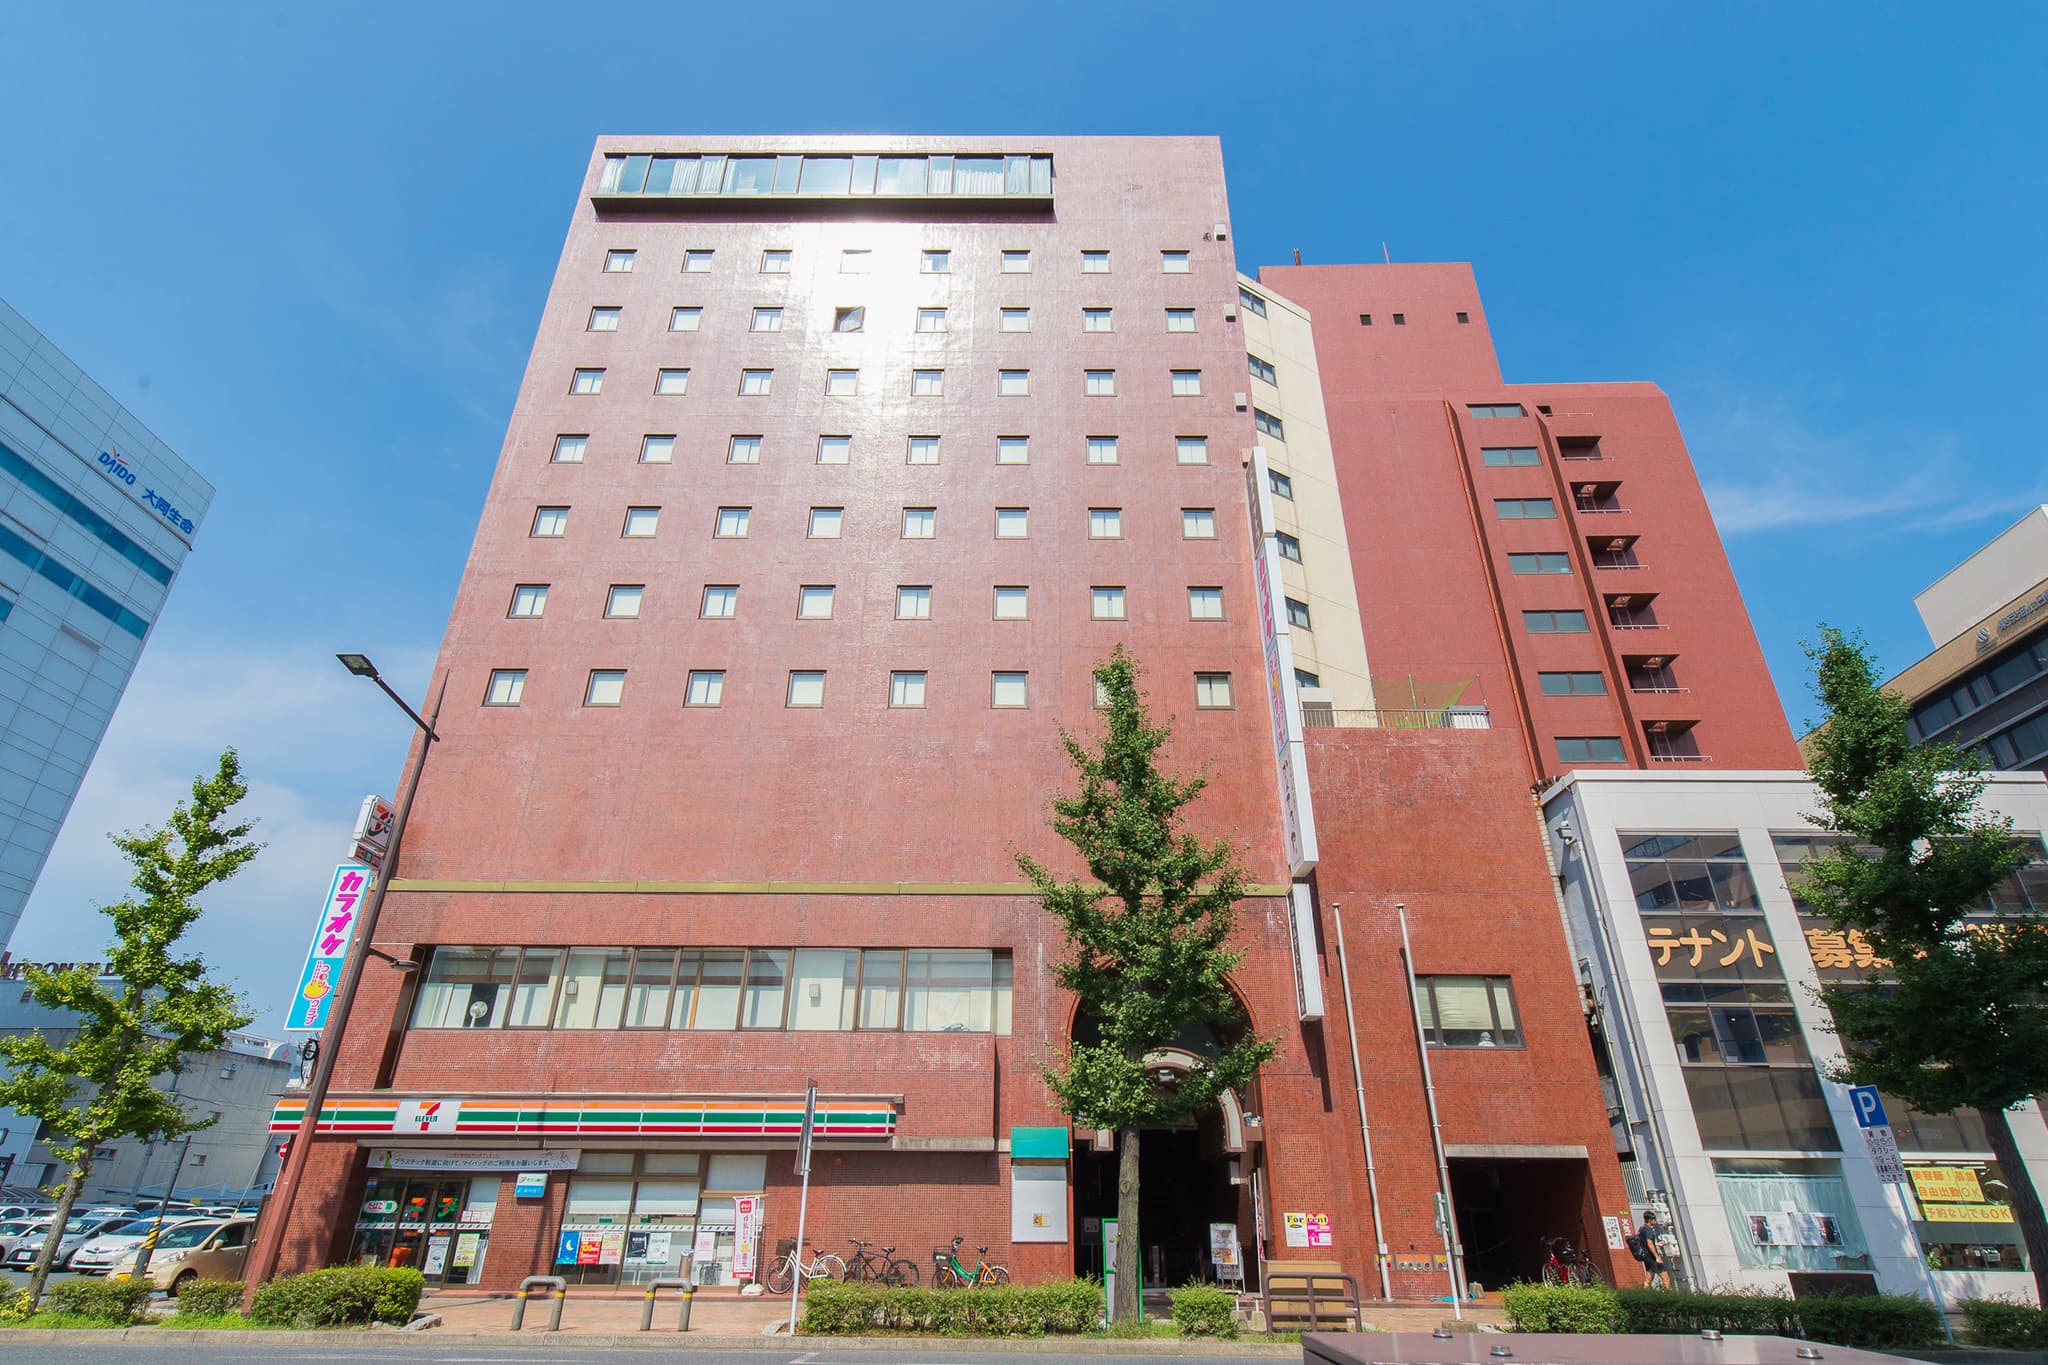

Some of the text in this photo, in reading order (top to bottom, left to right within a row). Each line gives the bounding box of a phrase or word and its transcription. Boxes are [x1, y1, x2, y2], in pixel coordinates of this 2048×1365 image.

[98, 451, 195, 535] DAIDO 大同生命
[320, 871, 364, 956] カラオケ
[1647, 926, 1775, 968] テナント
[419, 1101, 442, 1131] 7
[1856, 1091, 1877, 1124] P
[1286, 1215, 1328, 1224] For rent
